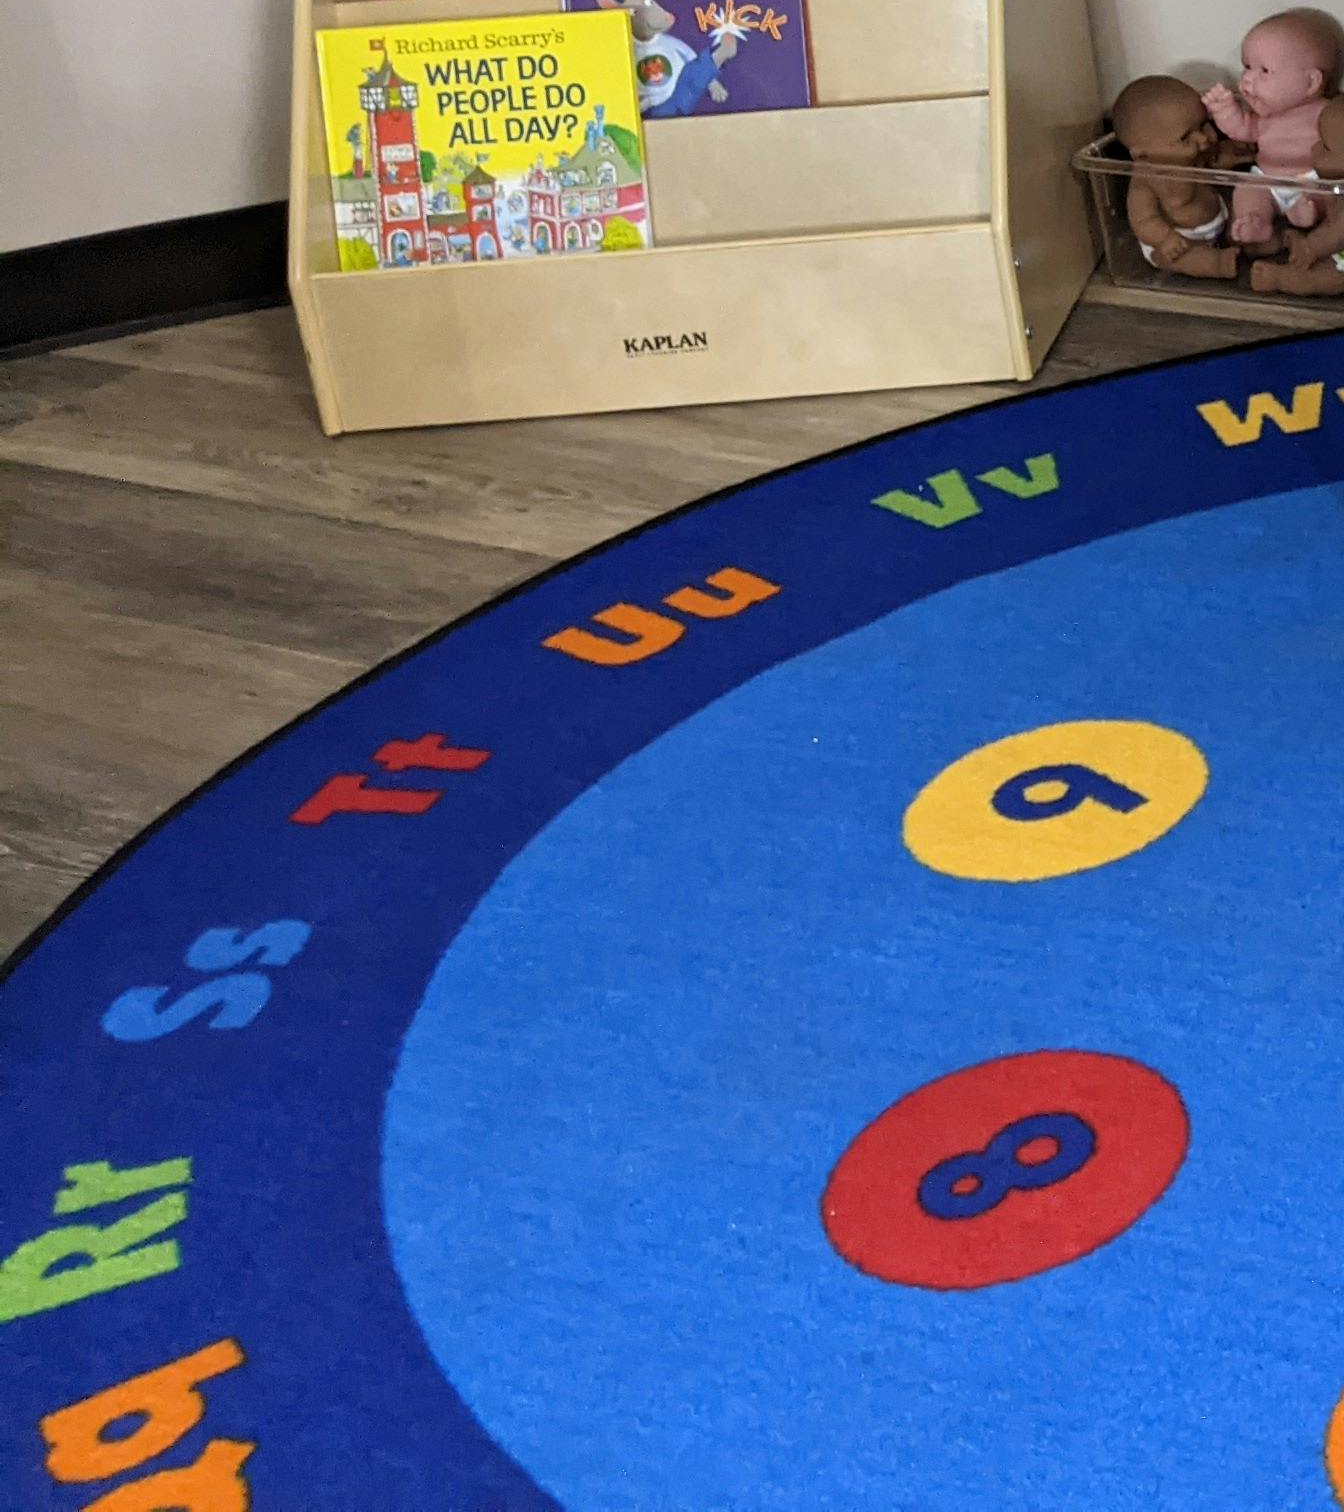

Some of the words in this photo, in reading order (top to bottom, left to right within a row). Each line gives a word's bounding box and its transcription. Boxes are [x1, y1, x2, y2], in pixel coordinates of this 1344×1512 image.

[395, 34, 479, 54] Richard
[484, 29, 565, 49] Scarry's
[425, 57, 509, 85] WHAT
[517, 55, 558, 80] DO
[437, 86, 538, 115] PEOPLE
[545, 83, 586, 108] DO
[449, 119, 498, 147] ALL
[506, 114, 578, 143] DAY?
[623, 331, 708, 353] KAPLAN
[289, 732, 492, 826] Tt
[917, 1110, 1098, 1222] 8
